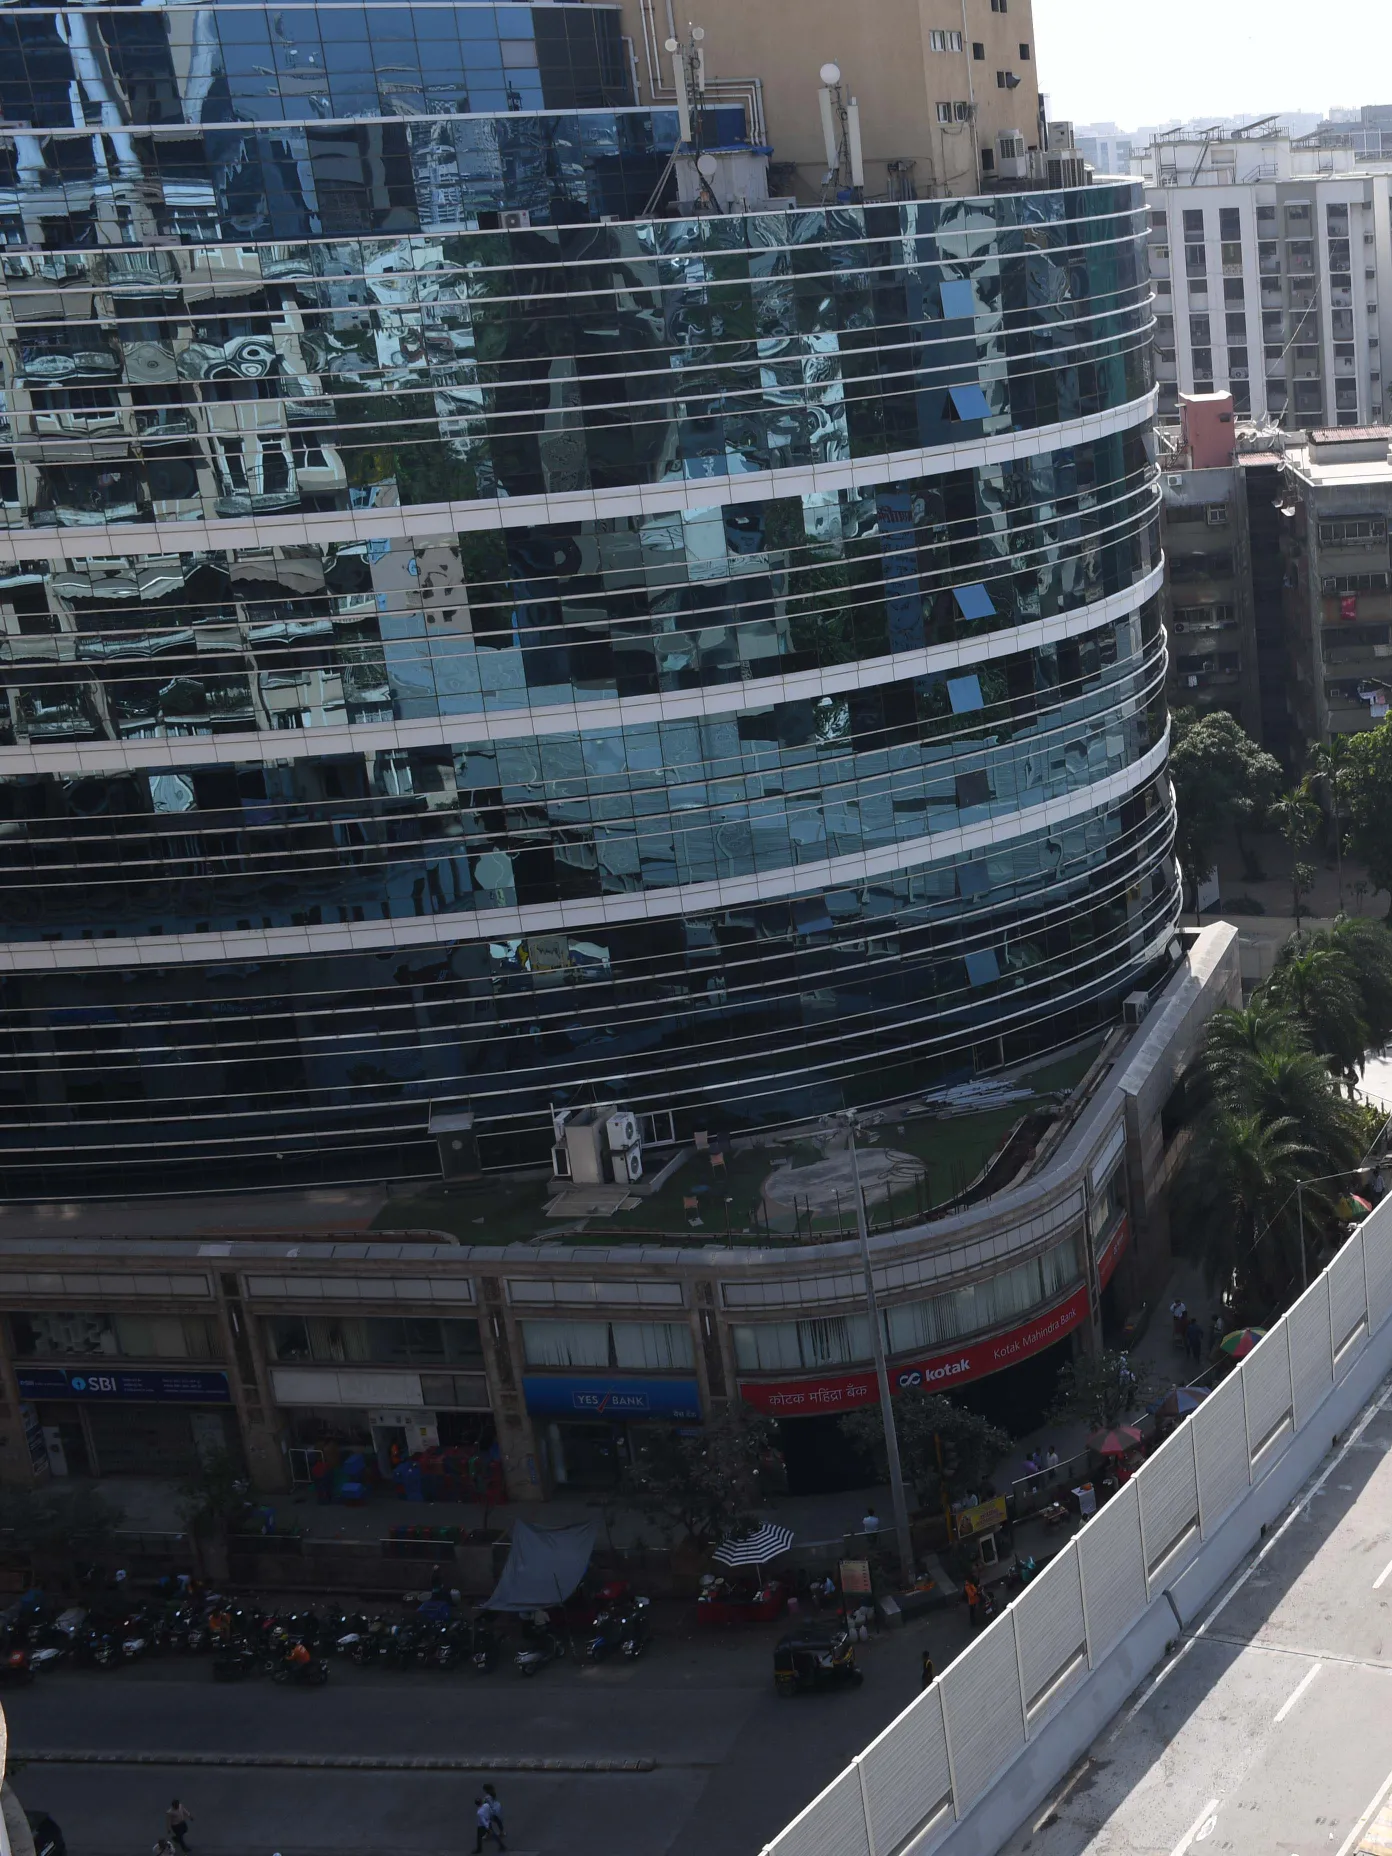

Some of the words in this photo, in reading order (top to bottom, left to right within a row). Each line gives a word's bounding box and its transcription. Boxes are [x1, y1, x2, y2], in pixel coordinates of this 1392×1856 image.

[993, 1340, 1021, 1360] Kotak
[1022, 1319, 1060, 1348] Mahindra
[1059, 1307, 1077, 1326] Bank
[925, 1358, 971, 1383] kotak
[88, 1376, 117, 1392] SBI
[577, 1394, 599, 1405] YES
[612, 1396, 645, 1406] BANK
[769, 1391, 805, 1406] कोटक
